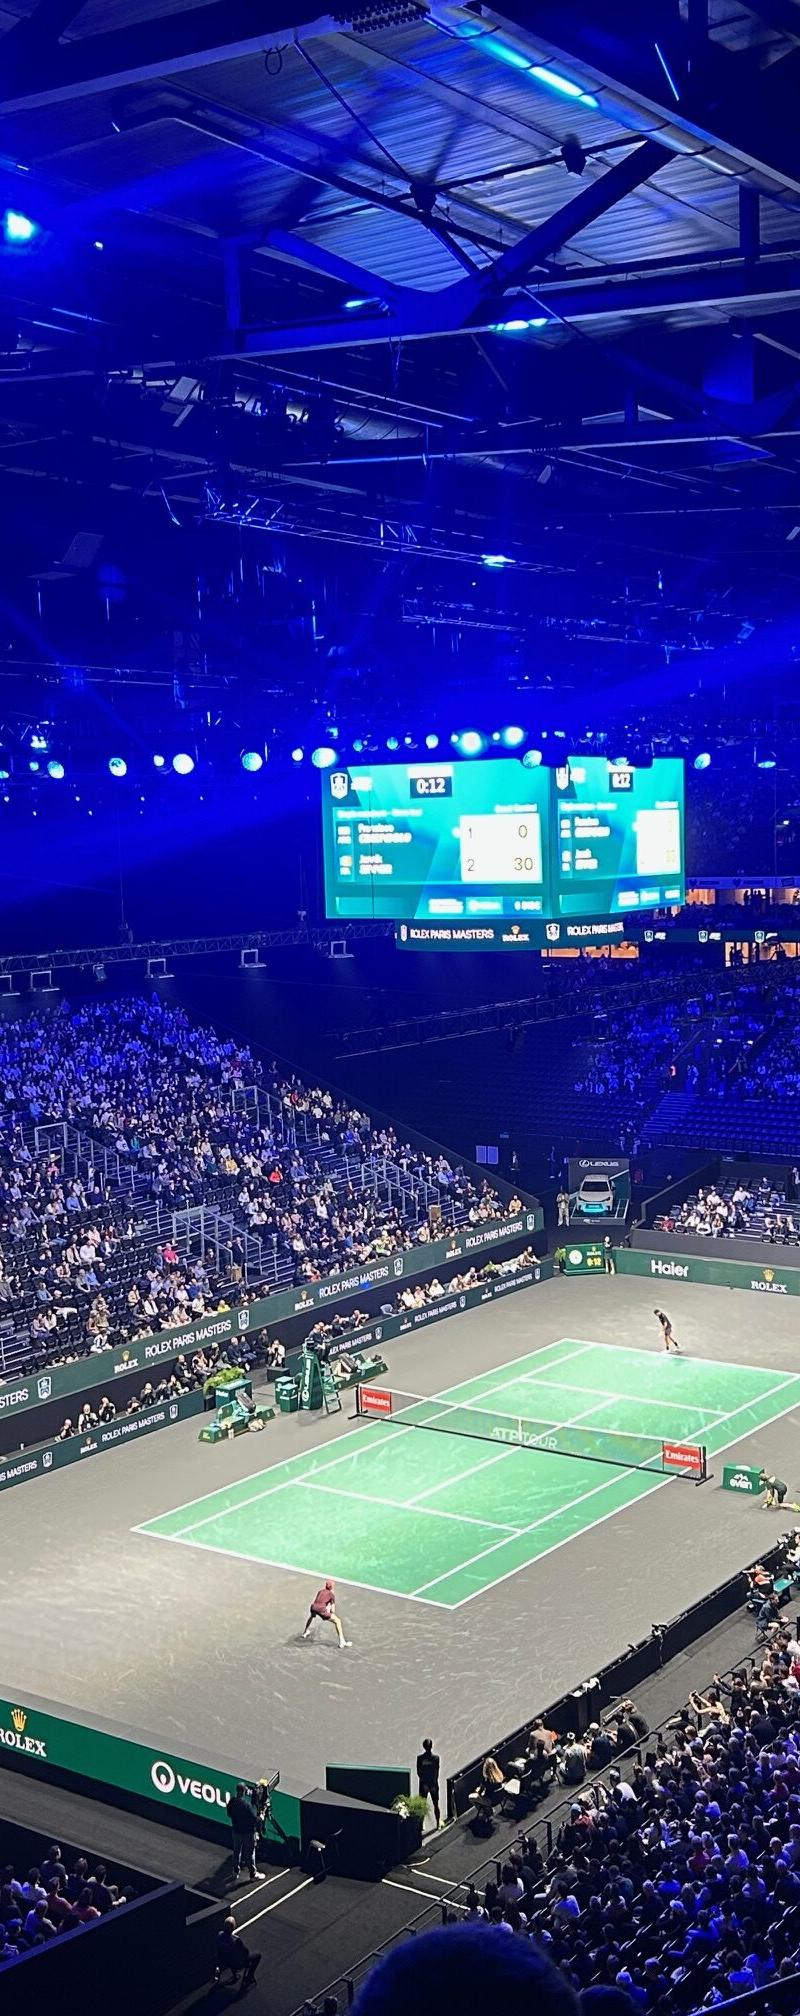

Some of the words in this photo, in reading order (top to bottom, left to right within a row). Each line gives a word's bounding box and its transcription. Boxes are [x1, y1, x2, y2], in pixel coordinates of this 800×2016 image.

[416, 777, 446, 794] 0:12
[468, 827, 473, 839] 1
[518, 824, 528, 838] 0
[467, 858, 476, 872] 2
[513, 857, 534, 871] 30
[410, 928, 430, 939] ROLEX
[430, 928, 451, 939] PARIS
[452, 928, 494, 939] MASTERS
[567, 925, 592, 936] ROLEX
[465, 1234, 484, 1249] ROLEX
[484, 1229, 499, 1243] PARIS
[499, 1221, 523, 1237] MASTERS
[650, 1259, 689, 1278] Haier
[319, 1282, 341, 1299] ROLEX
[341, 1276, 359, 1292] PARIS
[359, 1266, 389, 1285] MASTERS
[750, 1280, 788, 1294] ROLEX
[145, 1340, 172, 1359] ROLEX
[172, 1332, 195, 1350] PARIS
[196, 1319, 232, 1341] MASTERS
[114, 1358, 139, 1373] ROLEX
[362, 1394, 391, 1407] Emirates
[101, 1427, 122, 1442] ROLEX
[121, 1421, 138, 1435] PARIS
[138, 1411, 165, 1429] MASTERS
[523, 1432, 558, 1449] TOUR
[665, 1449, 700, 1464] Emirates
[6, 1460, 38, 1479] MASTERS
[729, 1477, 753, 1490] evian
[177, 1774, 231, 1808] VEOLI
